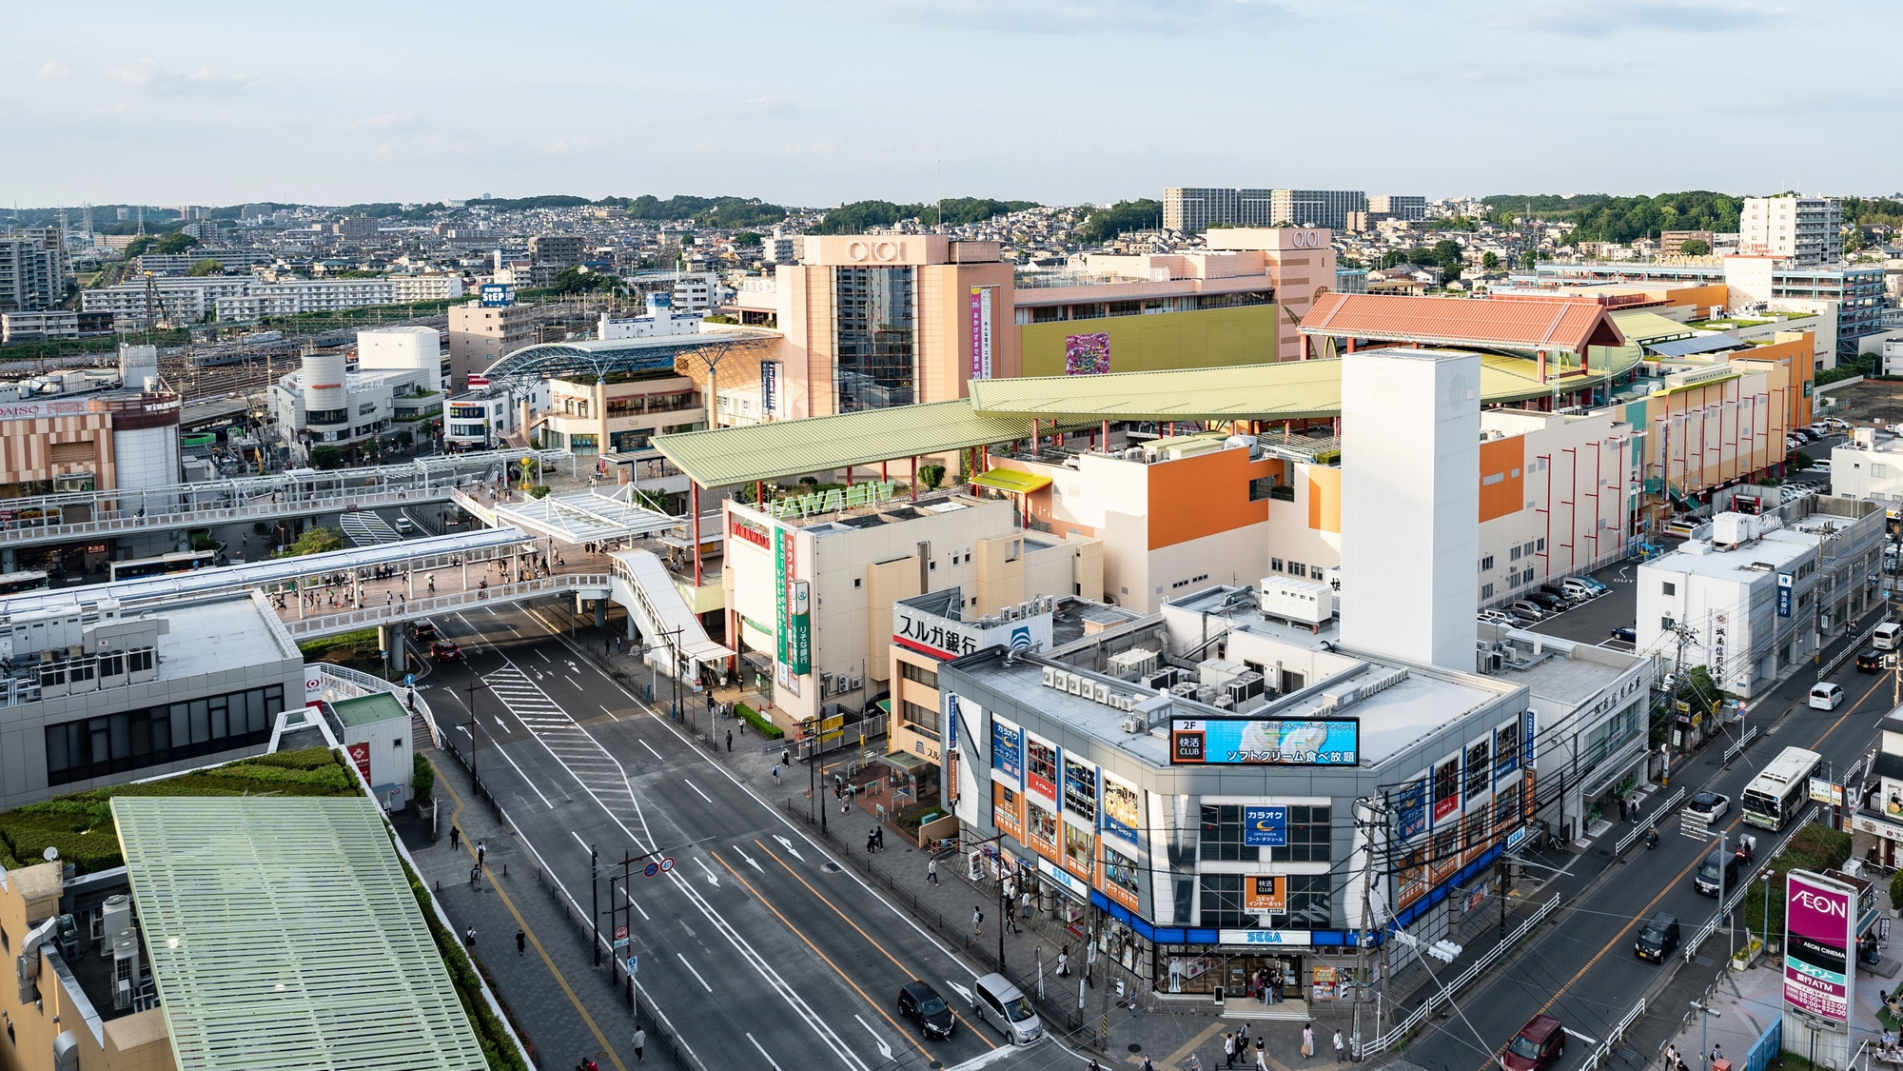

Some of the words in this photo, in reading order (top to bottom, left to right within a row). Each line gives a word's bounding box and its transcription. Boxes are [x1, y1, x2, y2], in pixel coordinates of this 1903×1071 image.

[899, 614, 977, 655] スルガ銀行
[1183, 721, 1196, 730] 2F
[1179, 737, 1199, 747] 快活
[1179, 747, 1200, 756] CLUB
[1226, 750, 1356, 763] ソフトクリーム食べ放題
[1248, 811, 1283, 820] カラオケ
[662, 861, 672, 869] 40
[1052, 867, 1072, 887] SEGA
[1246, 931, 1283, 943] SEGA
[1803, 941, 1821, 952] AEON
[1821, 946, 1846, 959] CINEMA
[1799, 963, 1834, 979] ダイソー
